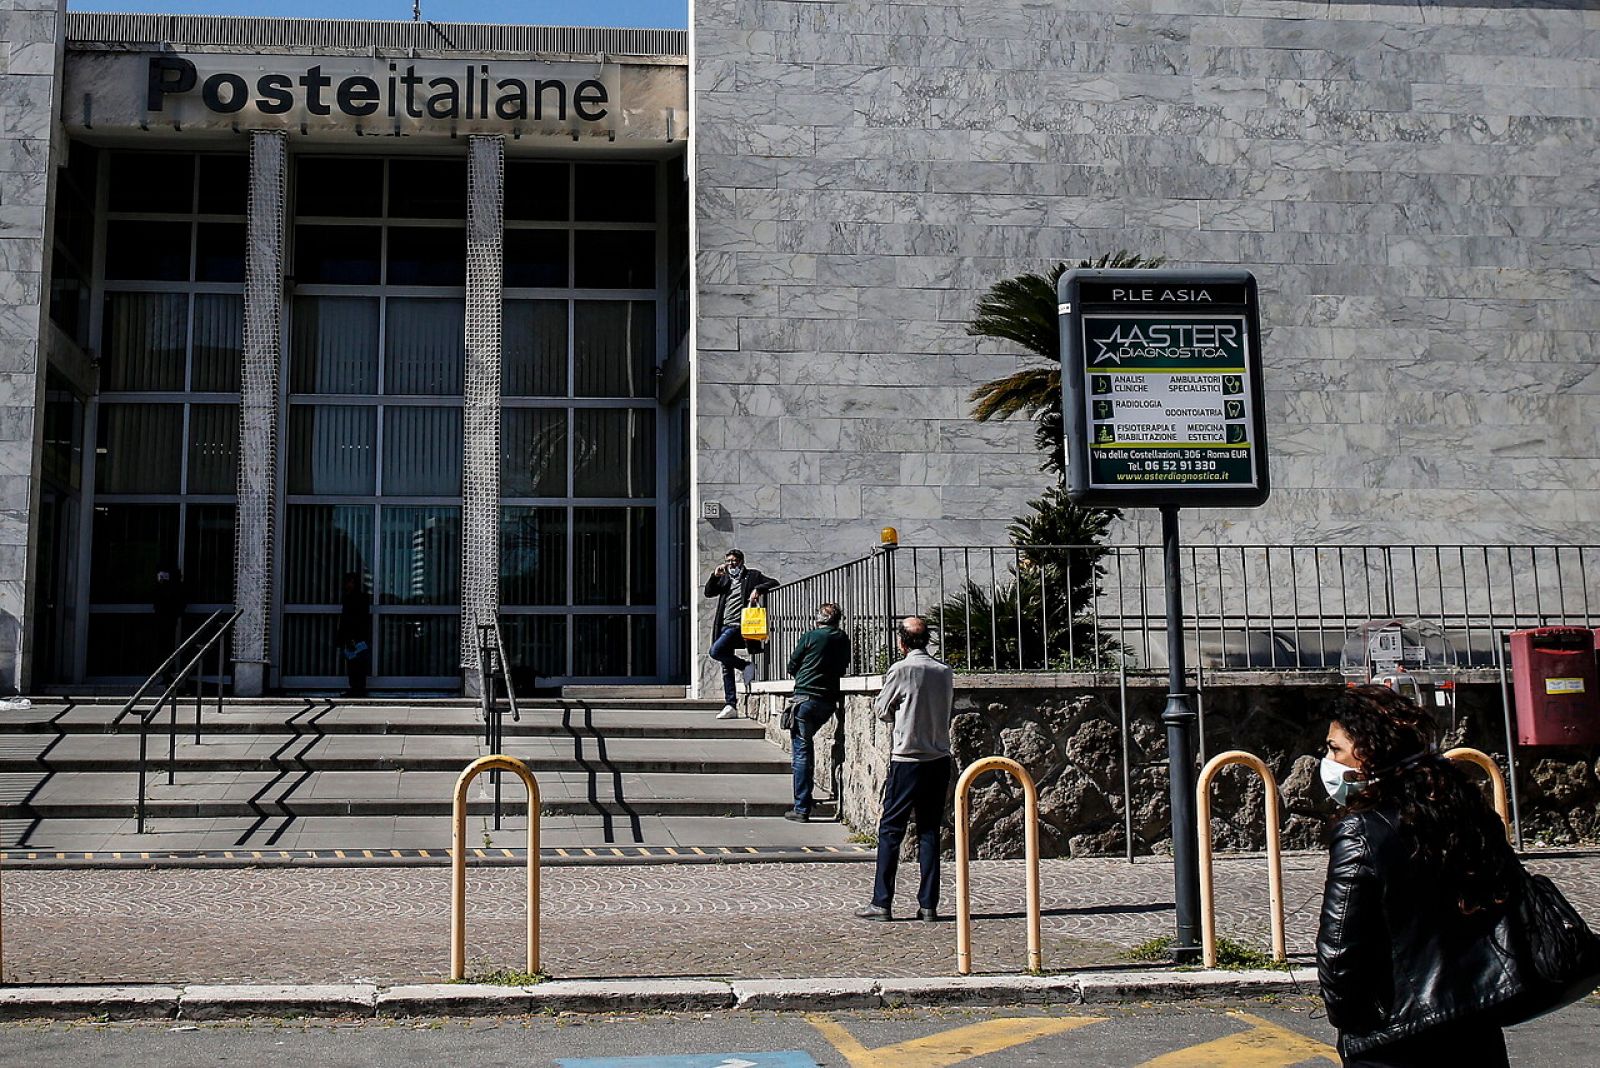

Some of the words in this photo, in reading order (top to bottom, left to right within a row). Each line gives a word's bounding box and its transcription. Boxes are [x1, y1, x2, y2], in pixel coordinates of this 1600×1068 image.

[1112, 289, 1153, 301] P.LE
[1160, 289, 1212, 301] ASIA
[1119, 347, 1228, 358] DIAGNOSTICA
[1114, 384, 1149, 392] CLINICHE
[1168, 384, 1221, 392] SPECIALISTICI
[1115, 400, 1162, 408] RADIOLOGIA
[1165, 408, 1223, 416] ODONTOIATRIA
[1117, 424, 1170, 432] FISIOTERAPIA
[1171, 424, 1176, 432] E
[1118, 433, 1178, 441] RIABILITAZIONE
[1188, 433, 1224, 441] ESTETICA
[1094, 450, 1107, 459] Via
[1108, 450, 1128, 459] delle
[1130, 450, 1183, 460] Costellazioni,
[1184, 450, 1200, 458] 306
[1207, 450, 1230, 458] Roma
[1231, 450, 1248, 458] EUR
[1127, 462, 1142, 471] Tel.
[1144, 460, 1160, 470] 06
[1162, 460, 1177, 470] 52
[1180, 460, 1192, 470] 91
[1194, 460, 1216, 470] 330
[1116, 472, 1229, 482] www.asterdiagnostica.it
